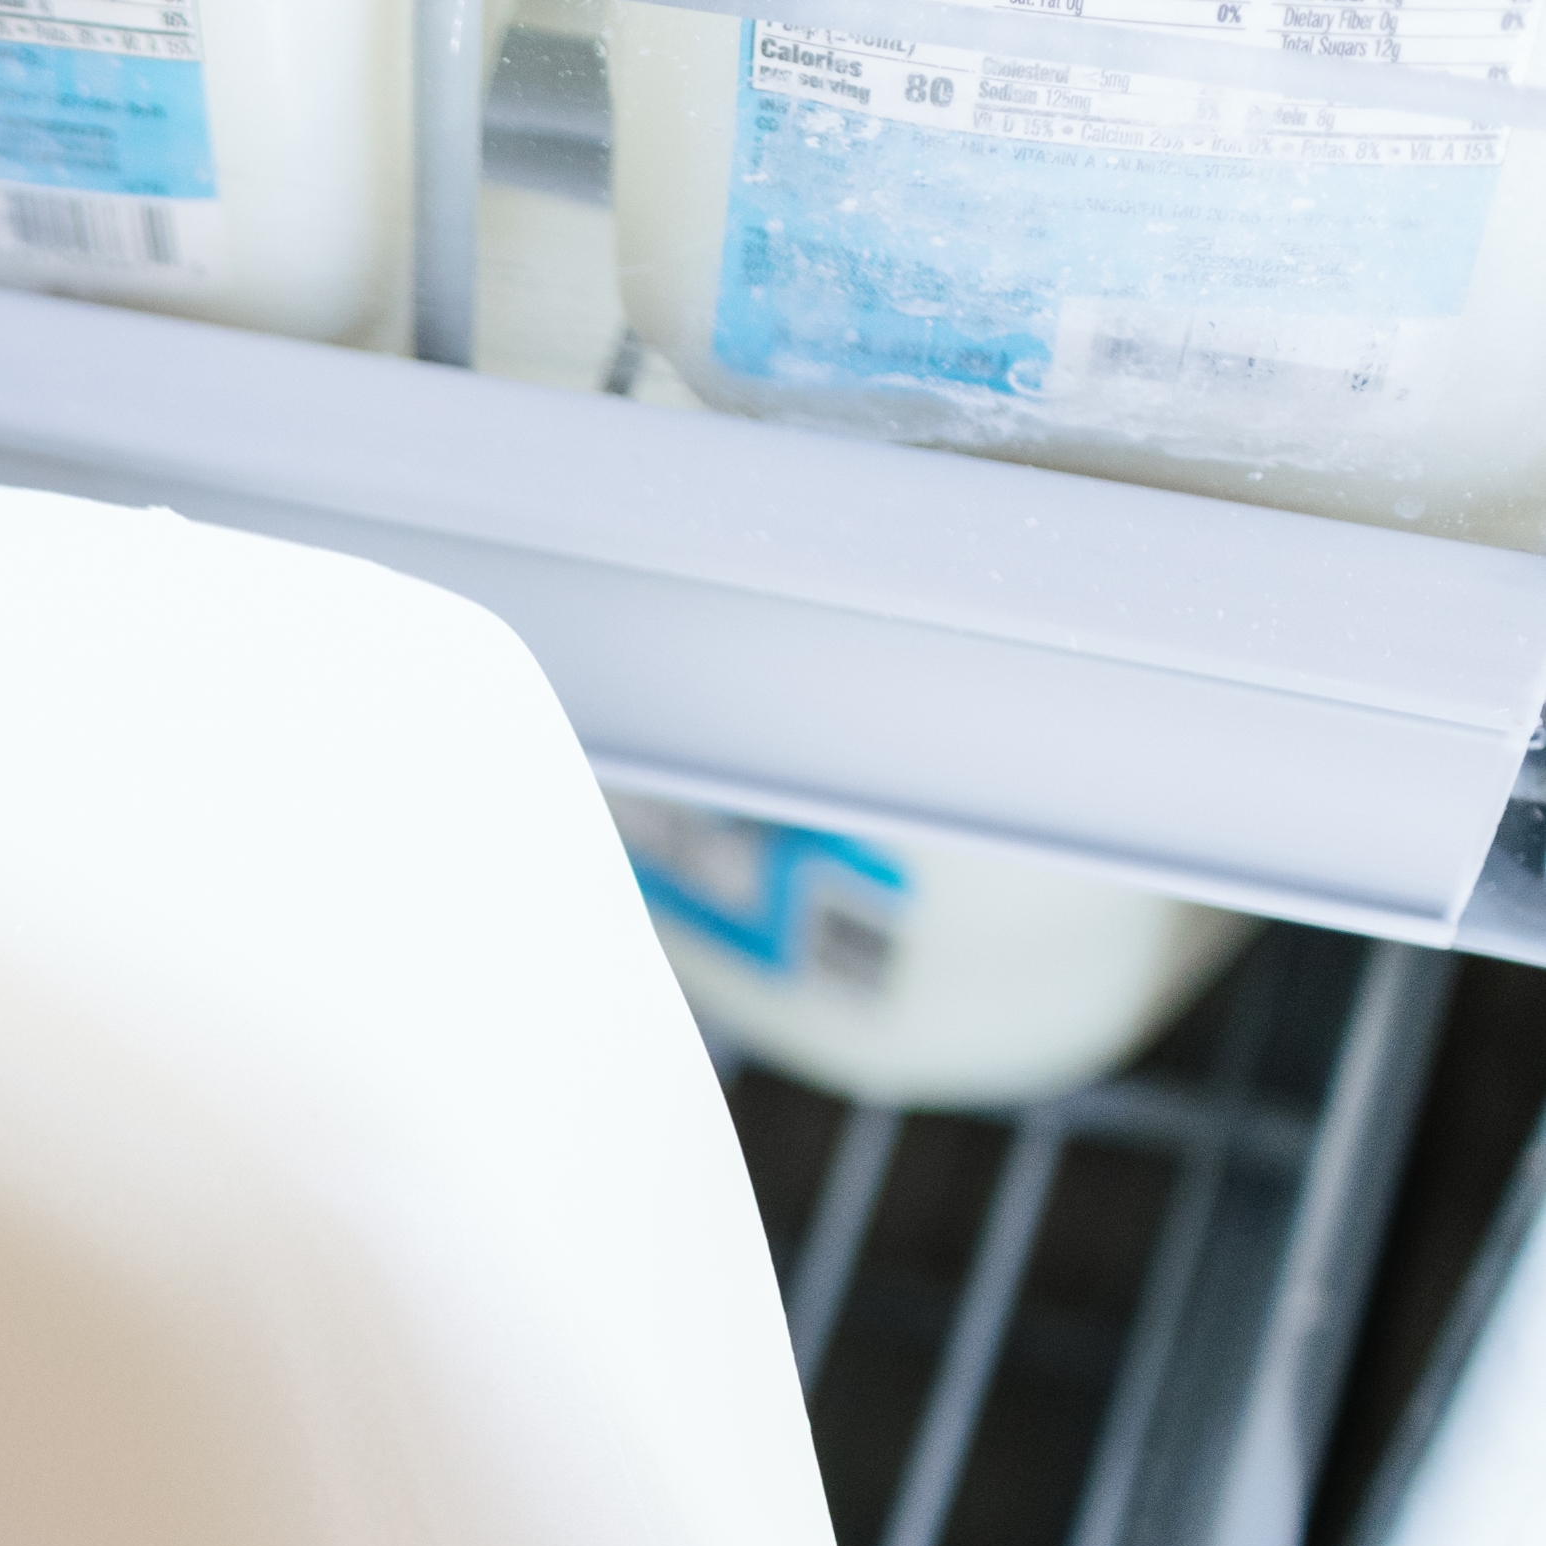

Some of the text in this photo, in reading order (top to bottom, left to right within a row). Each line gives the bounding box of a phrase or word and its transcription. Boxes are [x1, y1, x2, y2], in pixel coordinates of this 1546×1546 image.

[1216, 3, 1243, 24] 0%
[1283, 6, 1400, 35] Dietary Fiber 0g
[760, 37, 864, 78] Calories
[1280, 34, 1402, 63] Total Sugars 12g
[982, 56, 1071, 85] Cholesterol
[798, 71, 872, 106] serving
[904, 72, 955, 108] 80
[978, 80, 1092, 114] Sodium 125mg
[1316, 107, 1336, 131] 8g
[1003, 114, 1015, 133] D
[1080, 122, 1145, 148] Calcium
[1355, 141, 1381, 160] 8%
[1443, 142, 1456, 161] A
[1463, 141, 1497, 161] 15%
